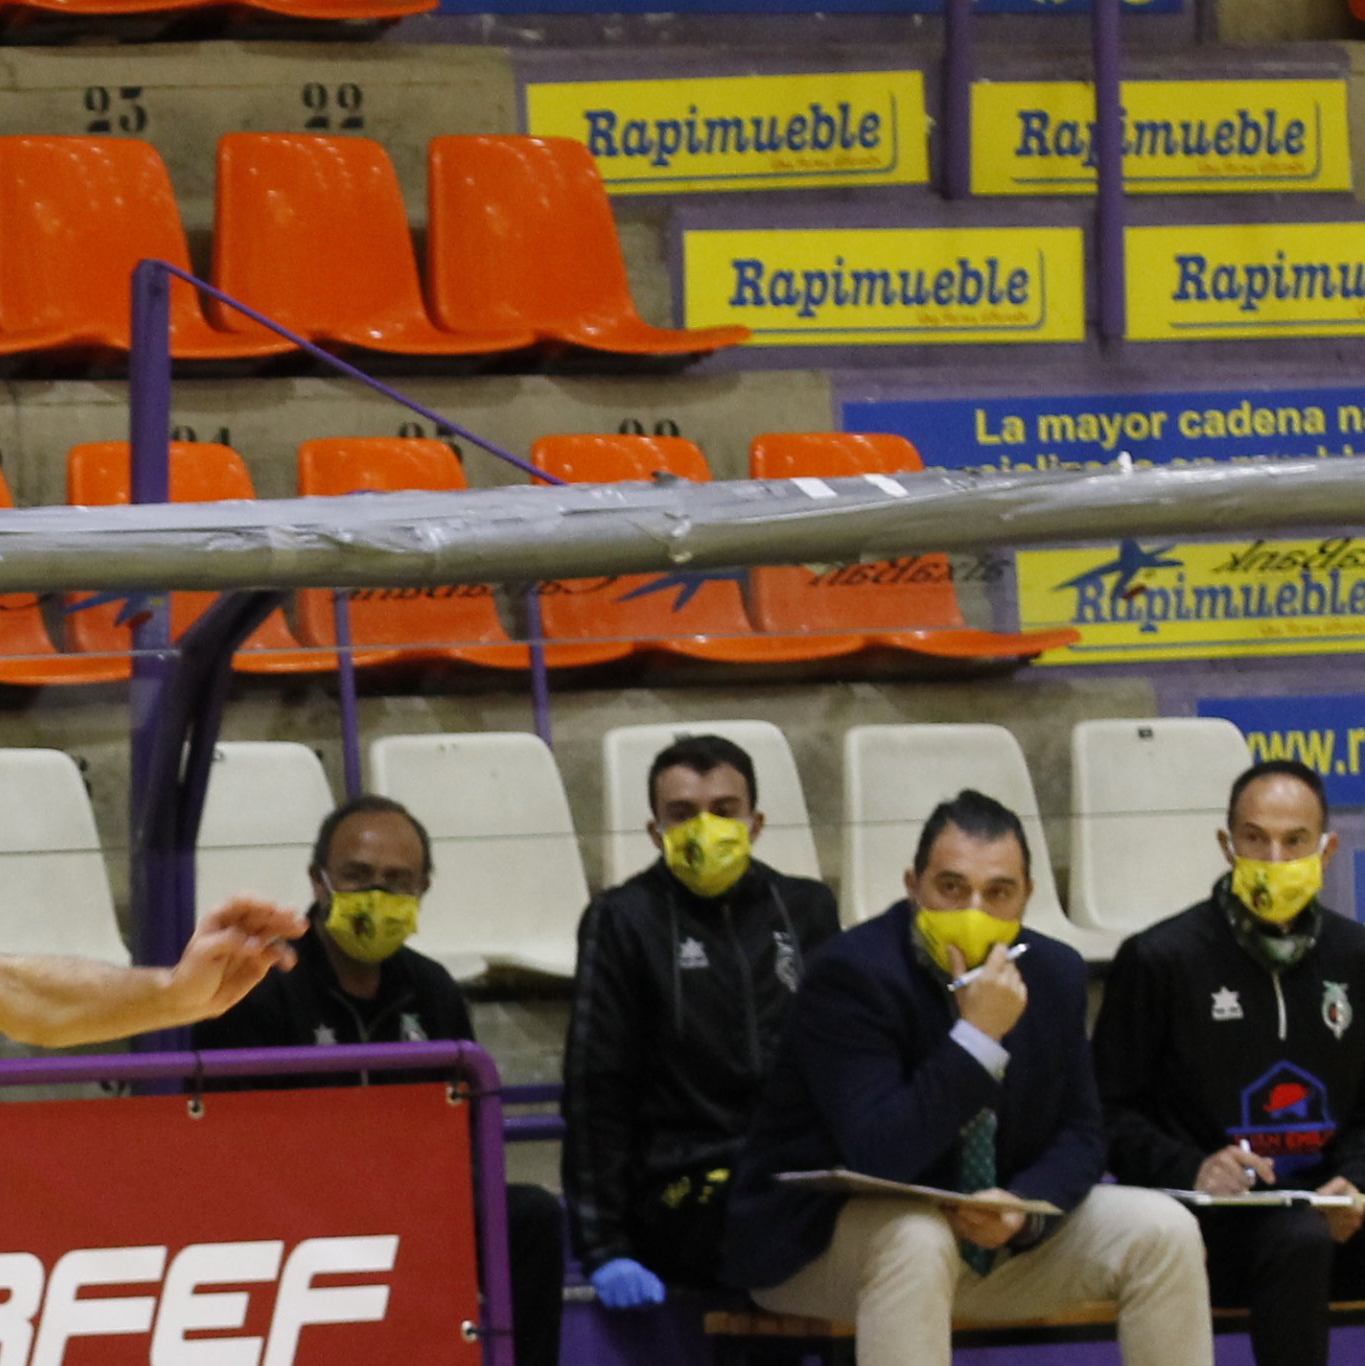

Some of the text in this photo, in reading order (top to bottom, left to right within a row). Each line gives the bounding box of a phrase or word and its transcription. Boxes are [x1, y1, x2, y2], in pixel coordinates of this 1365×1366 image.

[583, 102, 882, 168] Rapimueble
[729, 256, 1030, 319] Rapimueble
[975, 400, 1365, 450] La mayor cadena n
